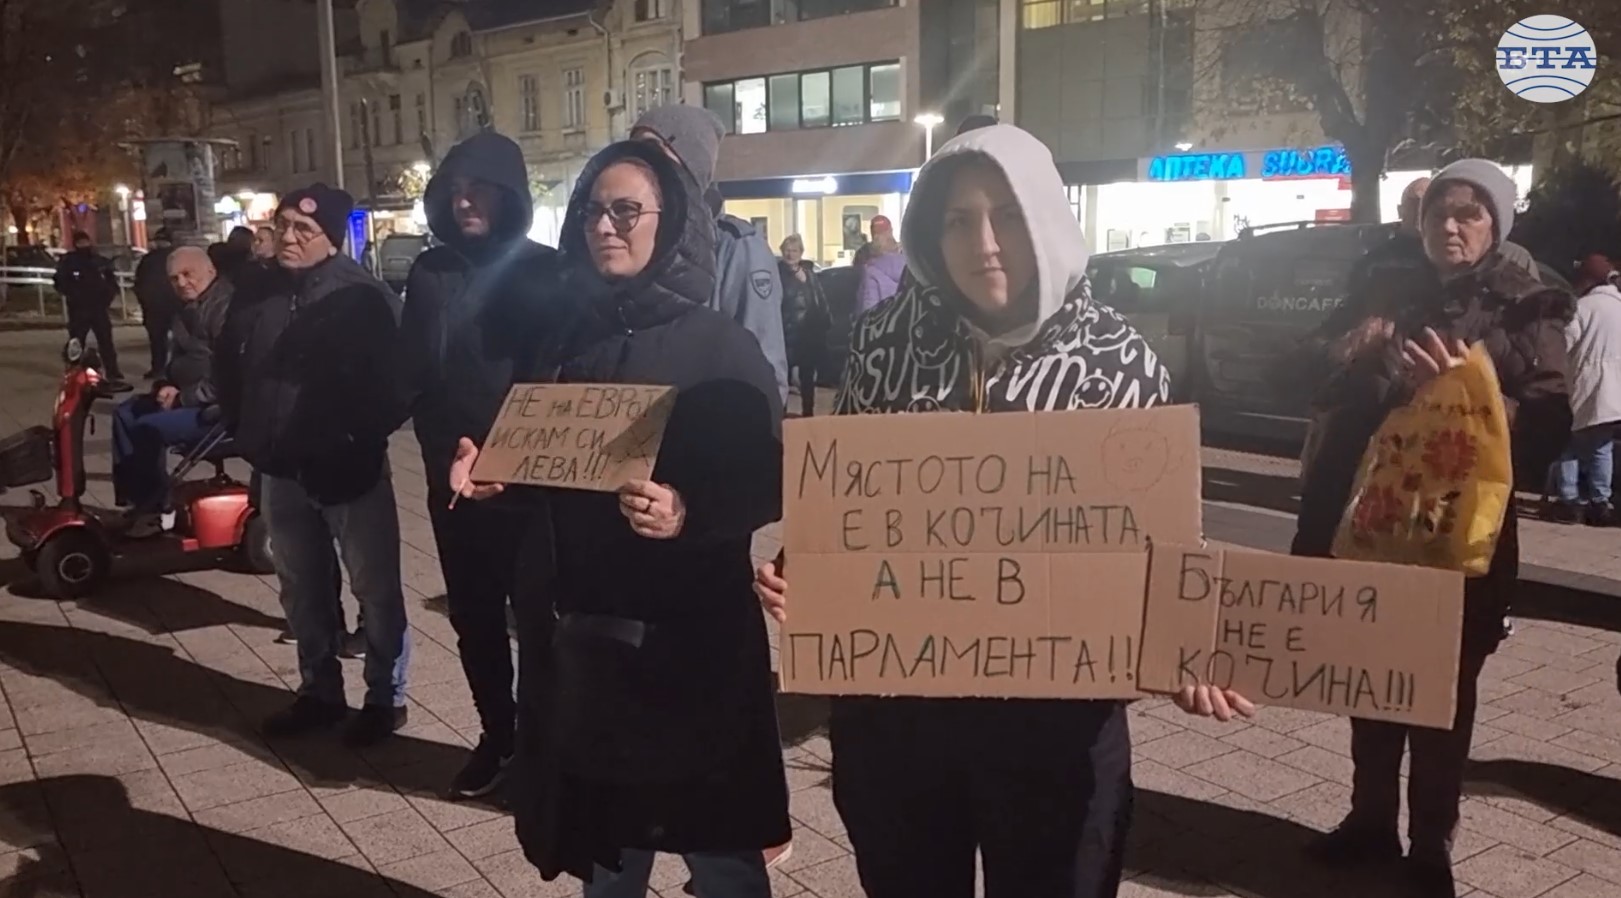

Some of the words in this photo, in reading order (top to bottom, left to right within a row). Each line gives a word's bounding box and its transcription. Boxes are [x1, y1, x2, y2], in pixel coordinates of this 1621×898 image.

[1149, 153, 1245, 182] АПТЕКА
[503, 386, 545, 418] НЕ
[491, 426, 570, 449] ИСКАМ
[575, 427, 606, 450] СИ
[1027, 455, 1077, 496] НА
[842, 508, 870, 551] Е
[885, 509, 904, 547] В
[871, 559, 901, 601] А
[919, 557, 977, 602] НЕ
[997, 557, 1027, 606] В
[1223, 619, 1268, 649] НЕ
[1286, 626, 1306, 652] Е
[788, 628, 1135, 685] ПАРЛАМЕНТА!!
